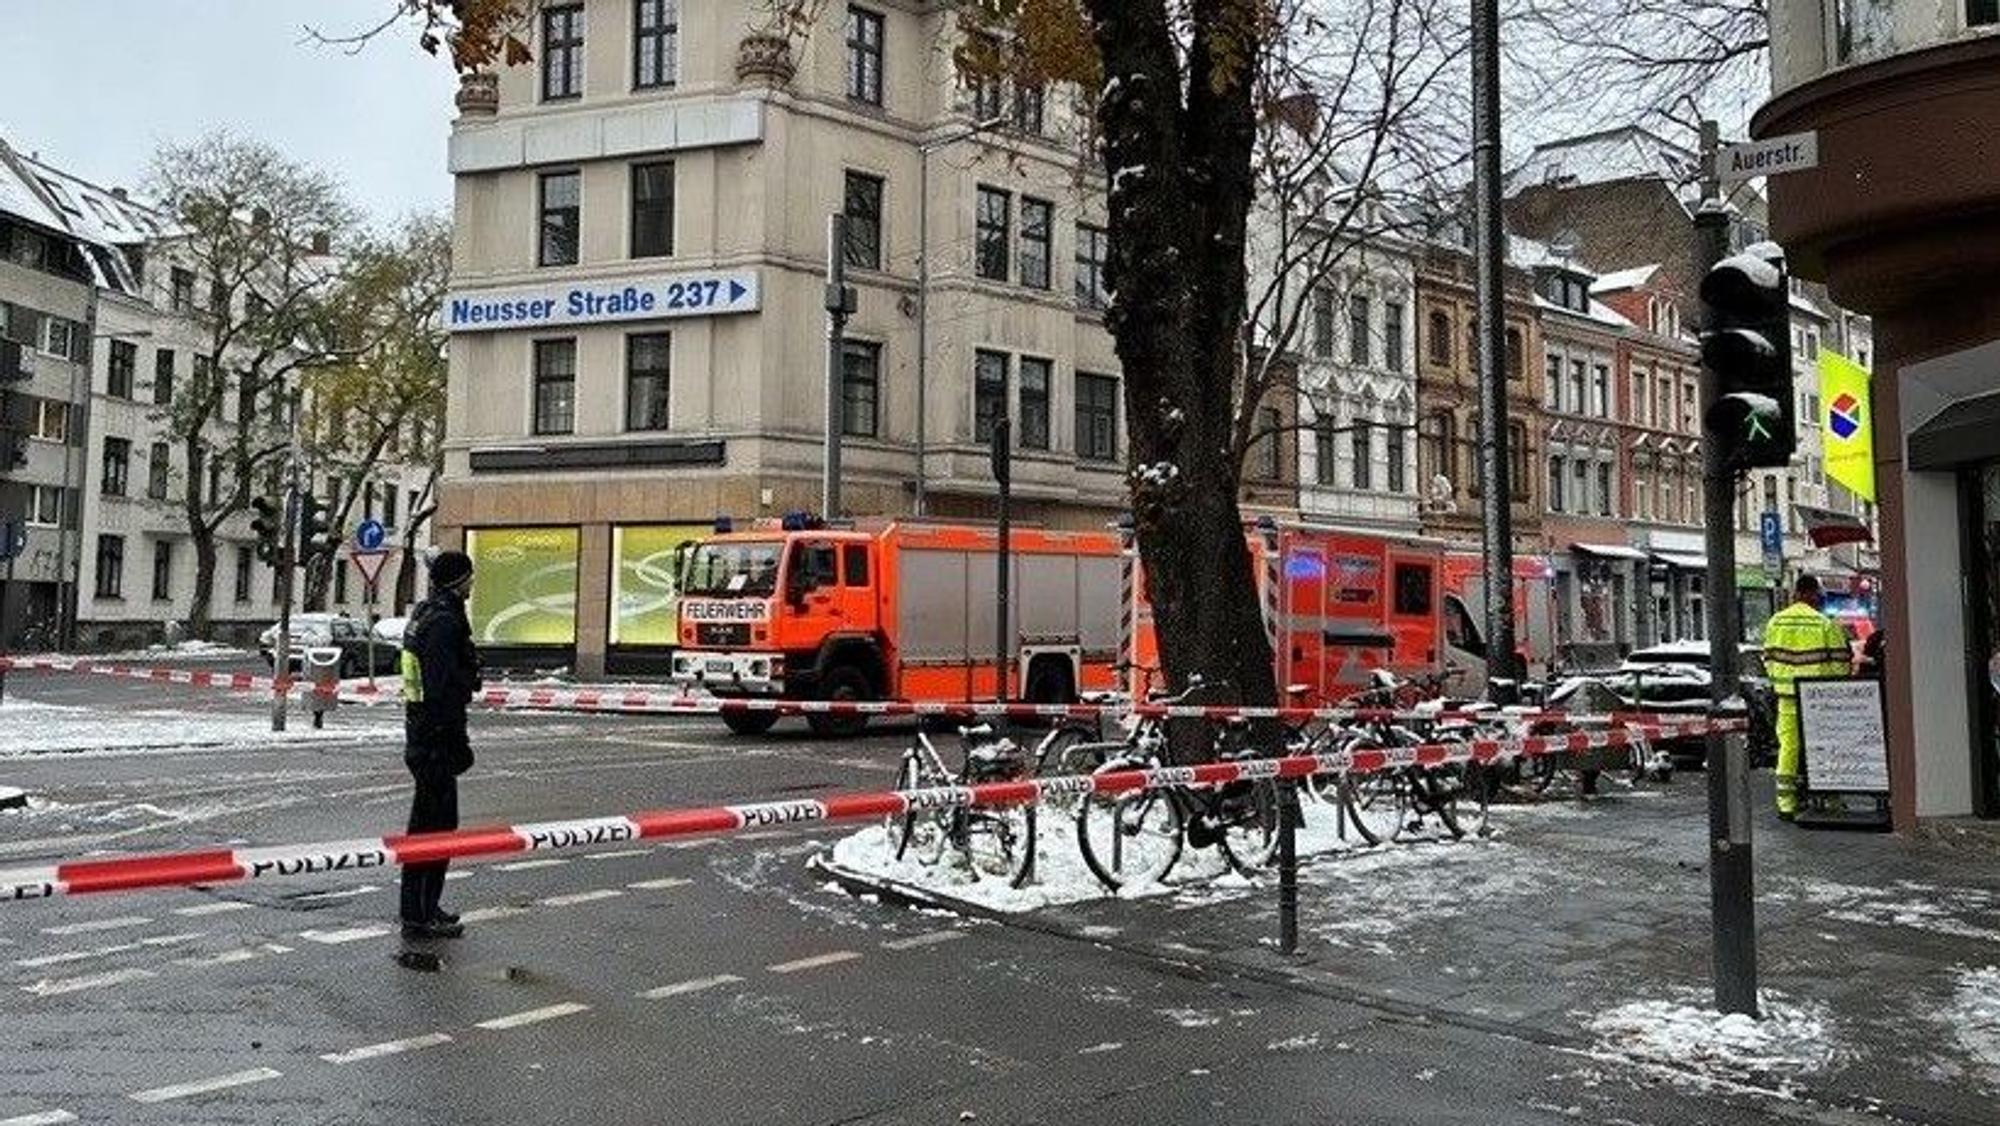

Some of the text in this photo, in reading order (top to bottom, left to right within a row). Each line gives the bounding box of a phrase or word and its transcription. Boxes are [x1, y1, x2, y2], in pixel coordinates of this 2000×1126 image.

[1731, 143, 1804, 171] Auerstr.
[452, 280, 720, 324] Neusser Straße 237
[1764, 517, 1777, 547] P
[687, 603, 766, 619] FEUERWEHR
[743, 803, 822, 826] POLIZEI
[530, 825, 632, 849] POLIZEI
